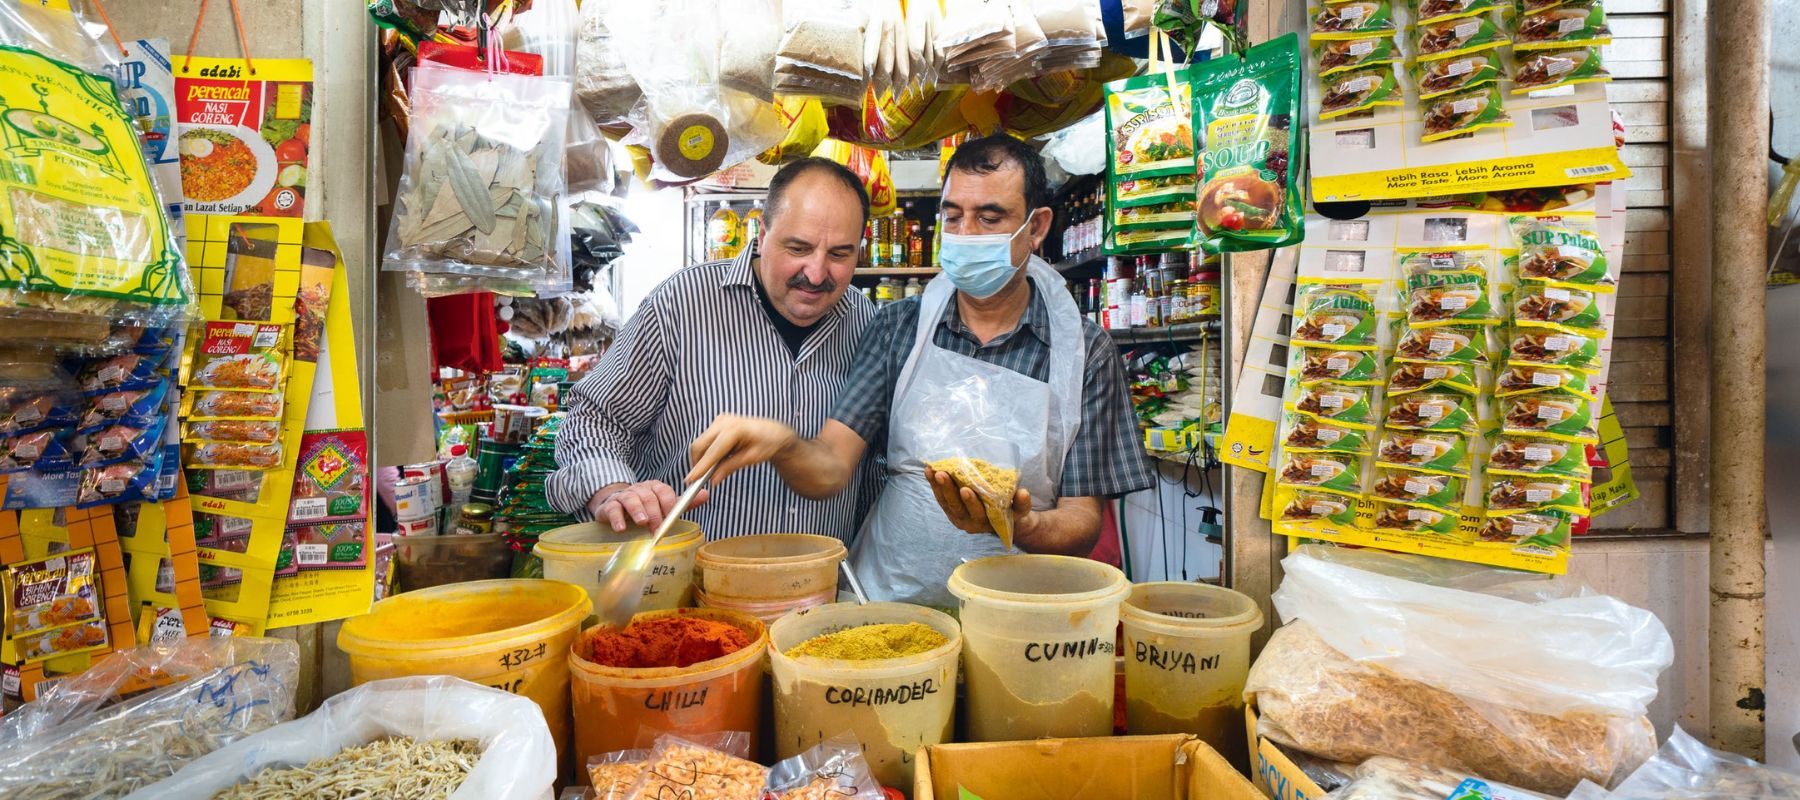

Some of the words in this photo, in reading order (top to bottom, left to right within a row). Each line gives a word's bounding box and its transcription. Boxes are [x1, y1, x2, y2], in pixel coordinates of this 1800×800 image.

[200, 65, 241, 78] adabi
[187, 82, 251, 102] perencah
[205, 102, 228, 113] NASI
[191, 112, 234, 125] GORENG
[1202, 140, 1271, 172] SOUP
[1386, 173, 1417, 183] Lebih
[1455, 165, 1488, 176] Lebih
[1492, 161, 1535, 172] Aroma
[1387, 181, 1417, 189] More
[1457, 174, 1488, 183] More
[1493, 169, 1536, 179] Aroma
[195, 202, 218, 212] Lazat
[219, 203, 243, 215] Setiap
[244, 204, 264, 214] Masa
[1522, 230, 1555, 246] SUP
[42, 472, 65, 481] More
[1609, 482, 1626, 494] Masa
[202, 499, 226, 510] adabi
[498, 643, 547, 670] #32#
[1025, 637, 1098, 663] CUMIN
[1135, 641, 1220, 674] BRIYANI
[825, 678, 938, 708] CORIANDER
